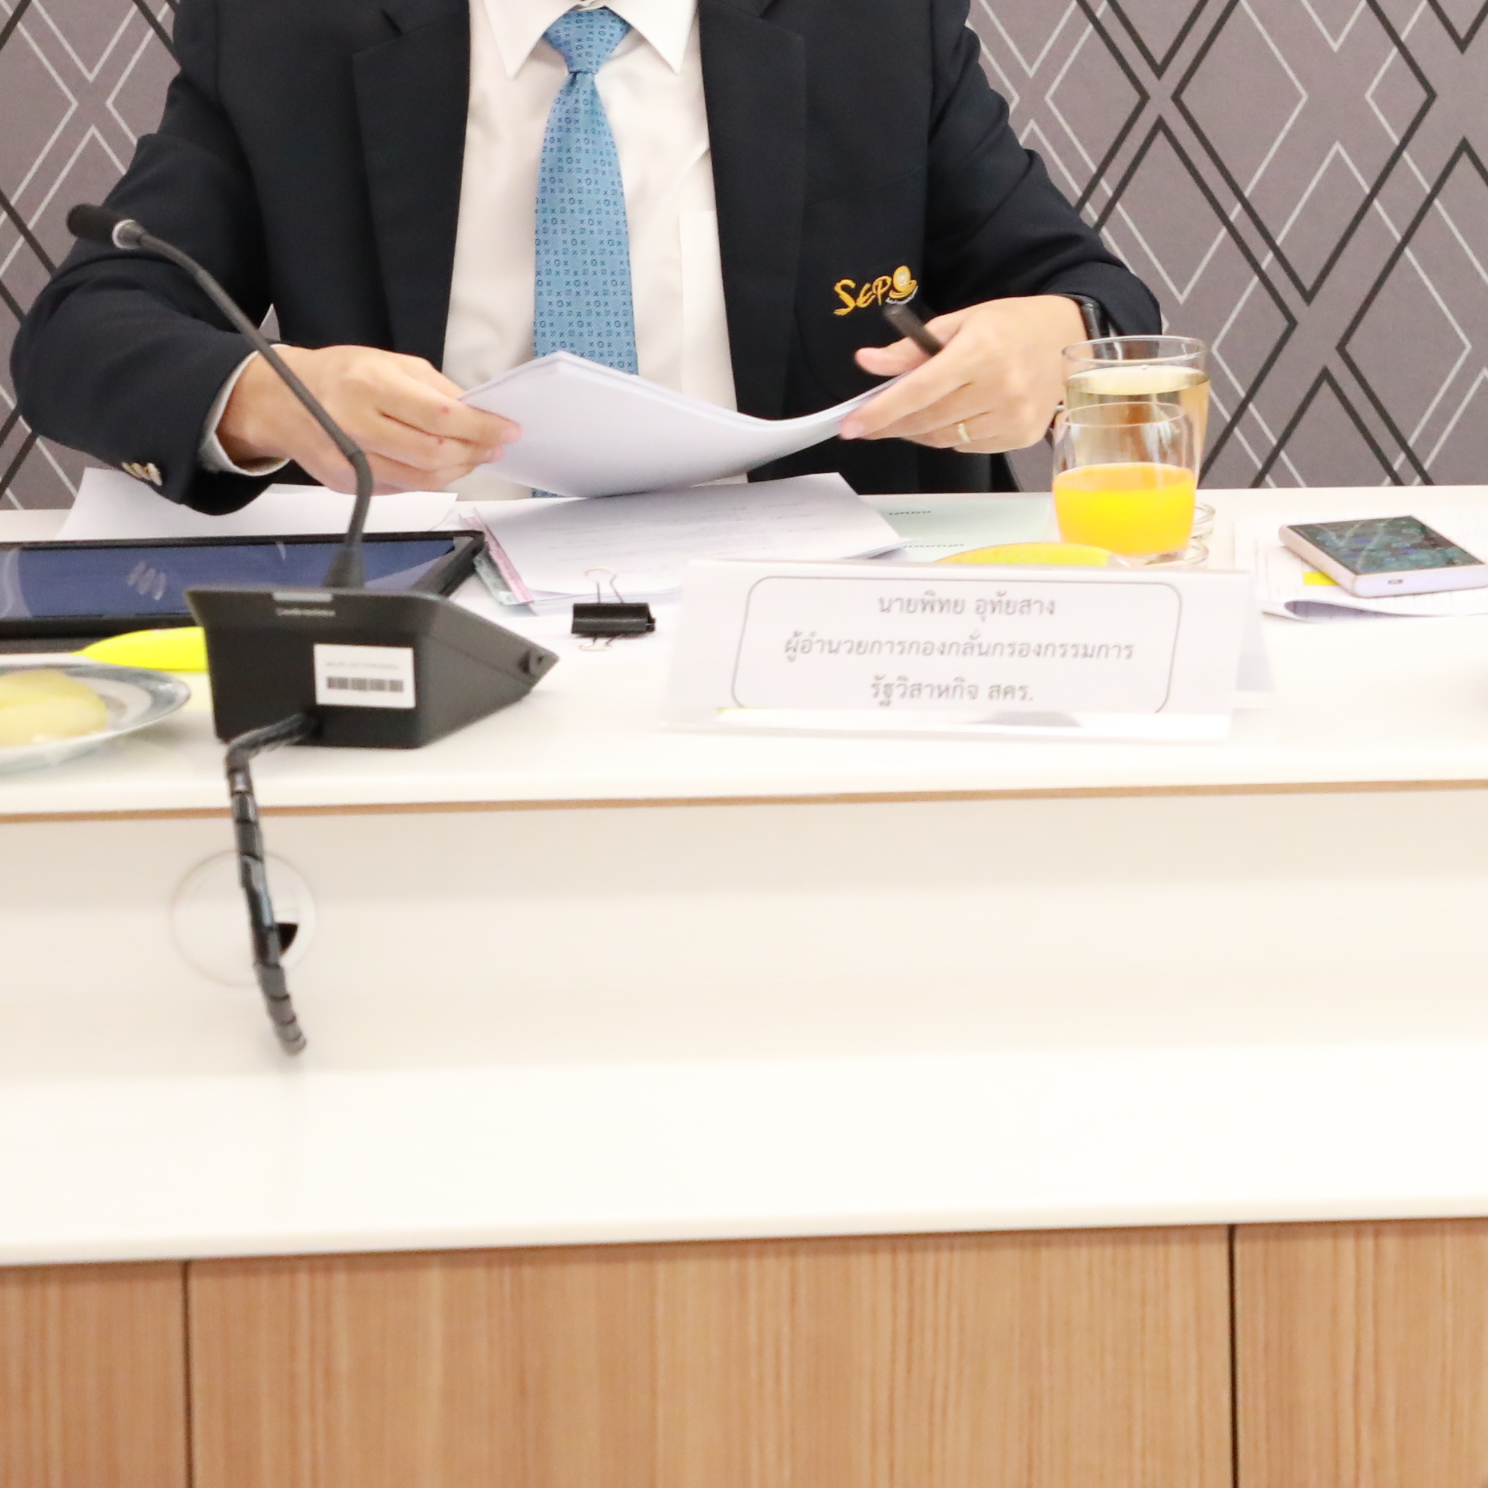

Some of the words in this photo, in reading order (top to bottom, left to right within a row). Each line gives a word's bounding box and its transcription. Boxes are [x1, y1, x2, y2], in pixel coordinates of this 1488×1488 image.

[877, 590, 966, 616] นายพิทย
[974, 591, 1057, 623] อุทัยสาง
[783, 628, 1135, 664] ผู้อำนวยการกองกลั่นกรองกรรมการ
[870, 674, 979, 708] รัฐวิสาหกิจ
[987, 683, 1035, 702] สคร.
